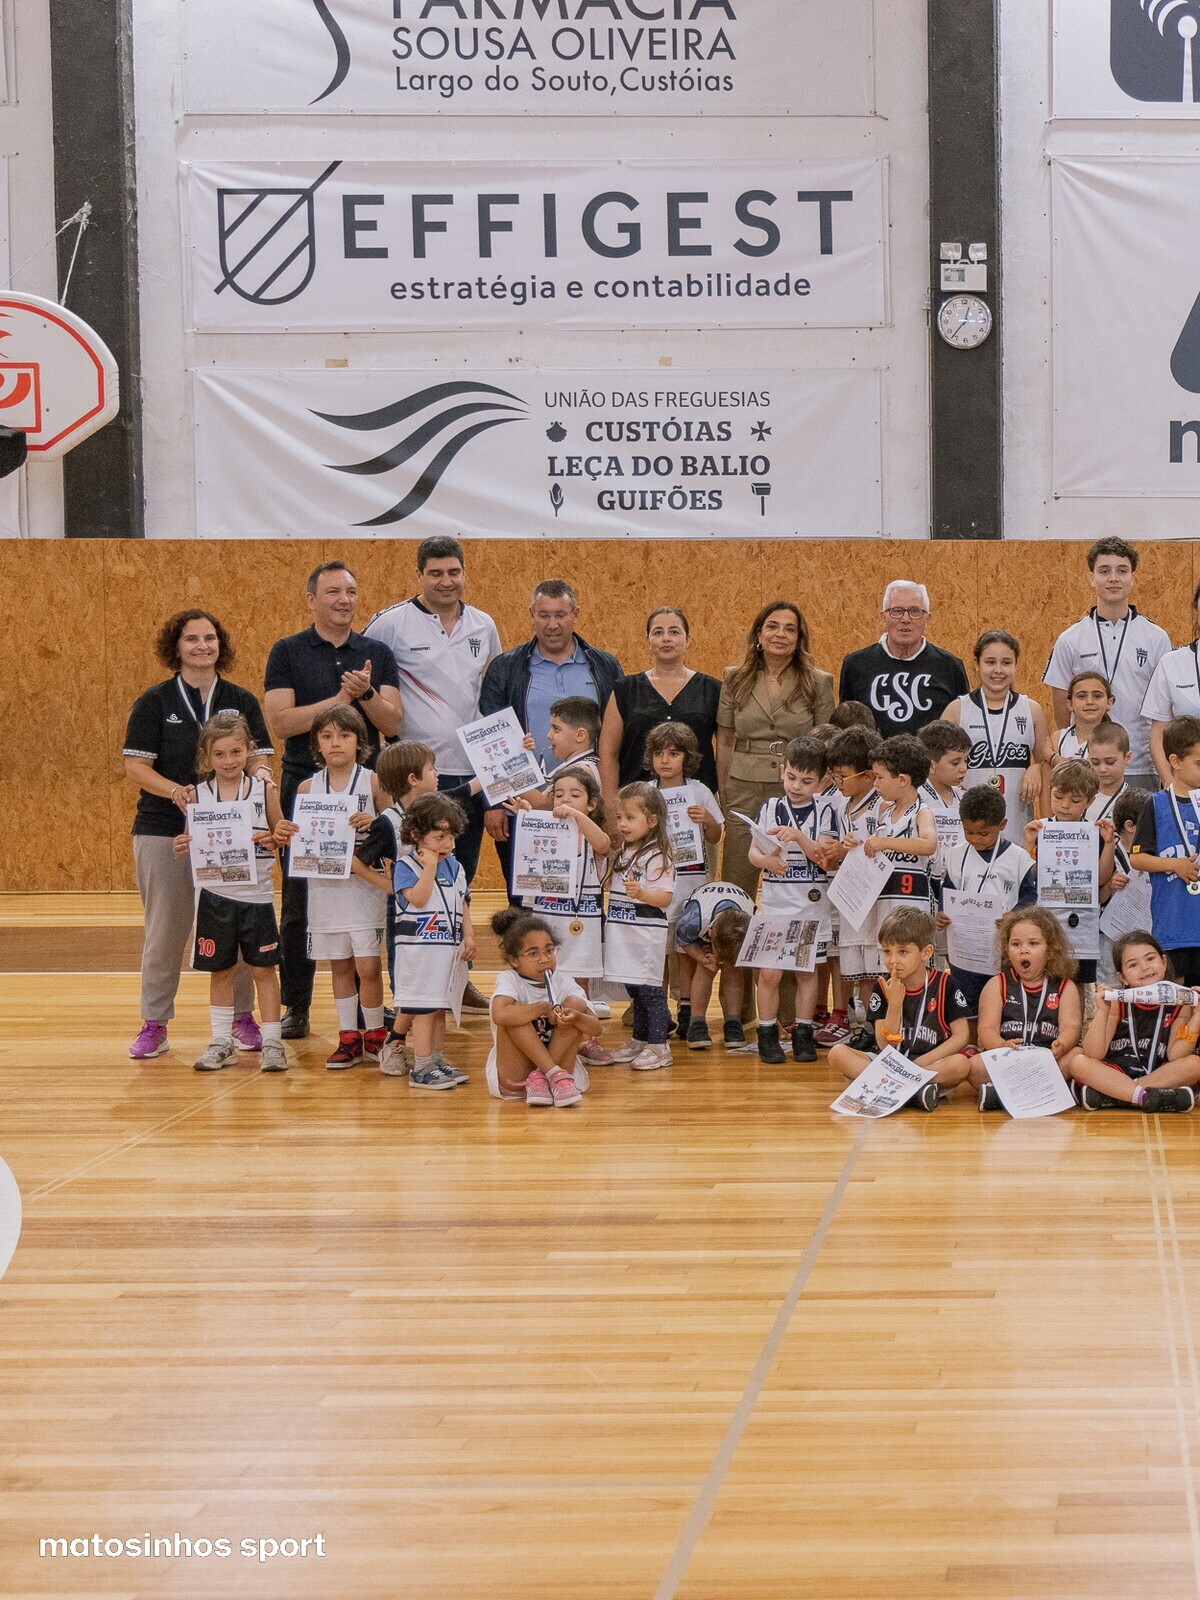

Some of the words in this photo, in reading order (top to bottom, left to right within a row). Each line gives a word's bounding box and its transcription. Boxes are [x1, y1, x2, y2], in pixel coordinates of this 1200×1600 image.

[392, 26, 537, 61] SOUSA
[551, 27, 737, 62] OLIVEIRA
[396, 66, 473, 99] Largo
[484, 64, 519, 91] do
[342, 189, 854, 259] EFFIGEST
[390, 274, 556, 306] estratégia
[566, 280, 584, 299] e
[593, 272, 811, 299] contabilidade
[545, 389, 606, 408] UNIÃO
[612, 391, 649, 408] DAS
[654, 391, 771, 408] FREGUESIAS
[585, 416, 732, 443] CUSTÓIAS
[547, 455, 625, 482] LEÇA
[631, 455, 674, 477] DO
[680, 454, 771, 476] BALIO
[596, 485, 723, 511] GUIFÕES
[870, 671, 933, 723] GSC
[900, 874, 913, 895] 9
[198, 937, 215, 957] 10
